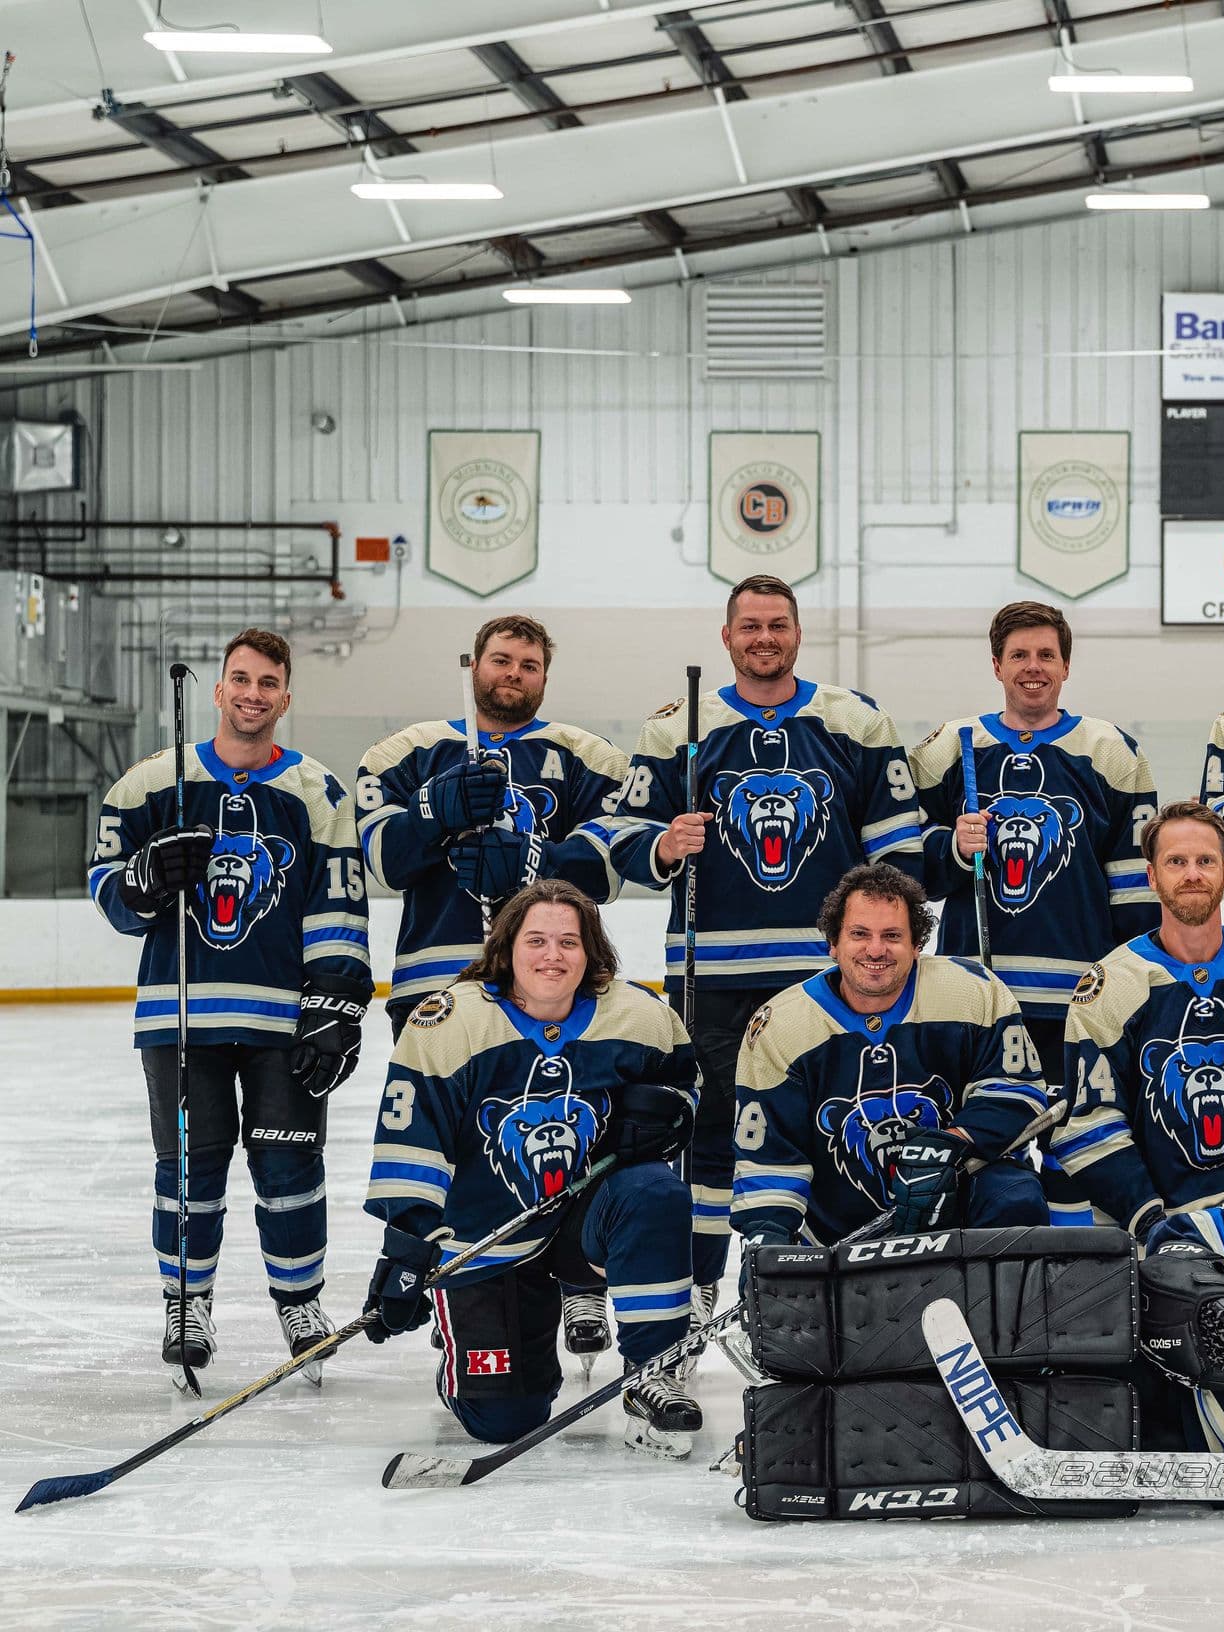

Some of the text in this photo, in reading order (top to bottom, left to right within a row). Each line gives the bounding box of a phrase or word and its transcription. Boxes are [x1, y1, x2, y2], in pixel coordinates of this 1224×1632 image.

[1166, 408, 1207, 418] PLAYER
[541, 749, 564, 781] A
[96, 815, 122, 860] 5
[326, 857, 366, 902] 15
[687, 864, 696, 923] NEXUS
[381, 1079, 416, 1131] 3
[847, 1234, 950, 1263] CCM
[1158, 1243, 1204, 1254] CCM
[936, 1342, 1022, 1453] NOPE
[849, 1488, 959, 1512] CCM
